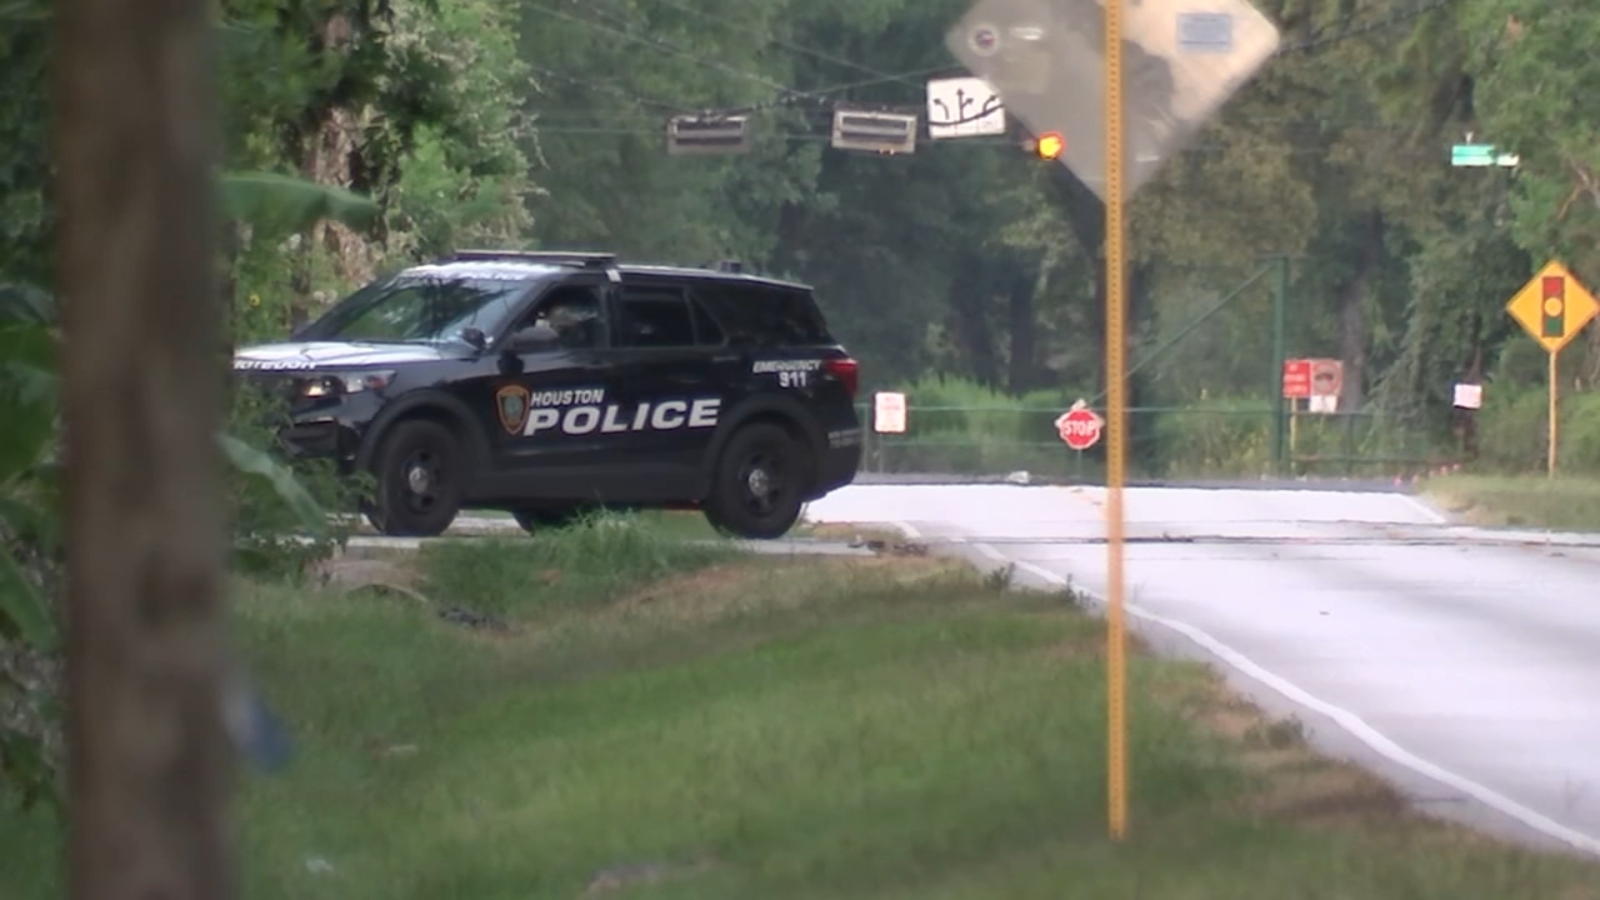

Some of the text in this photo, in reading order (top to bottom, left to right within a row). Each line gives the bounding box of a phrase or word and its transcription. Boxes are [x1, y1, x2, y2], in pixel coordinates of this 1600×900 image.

[752, 360, 822, 373] EMERGENCY
[779, 371, 806, 388] 911
[530, 389, 605, 406] HOUSTON
[523, 398, 721, 436] POLICE
[1063, 420, 1096, 436] STOP
